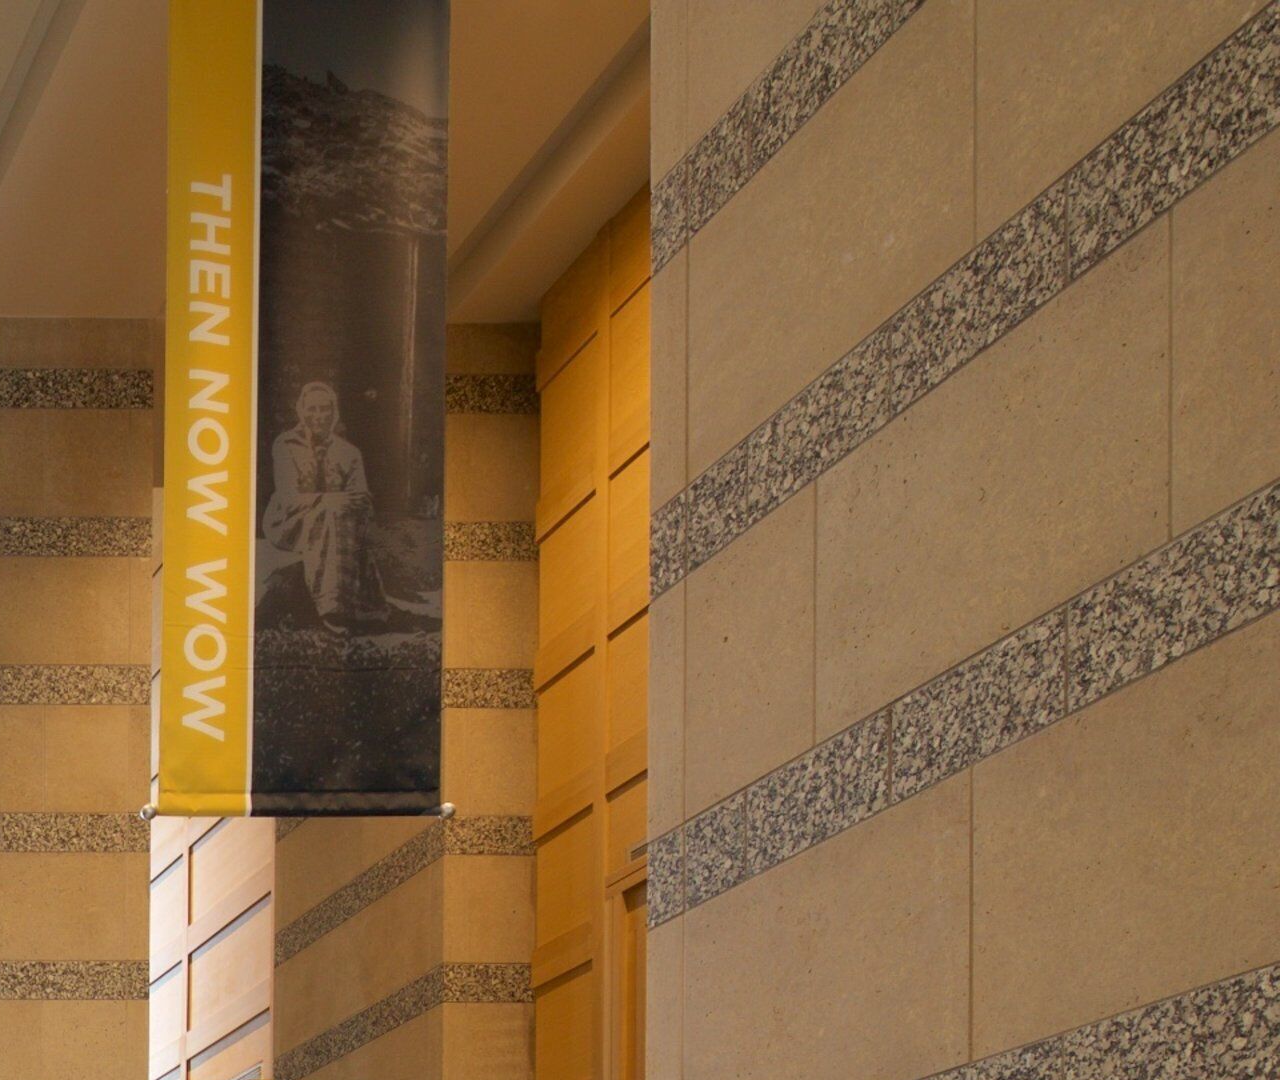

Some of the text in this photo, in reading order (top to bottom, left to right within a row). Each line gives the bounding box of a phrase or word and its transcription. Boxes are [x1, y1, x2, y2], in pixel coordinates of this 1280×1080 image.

[181, 173, 232, 742] THEN NOW WOW
